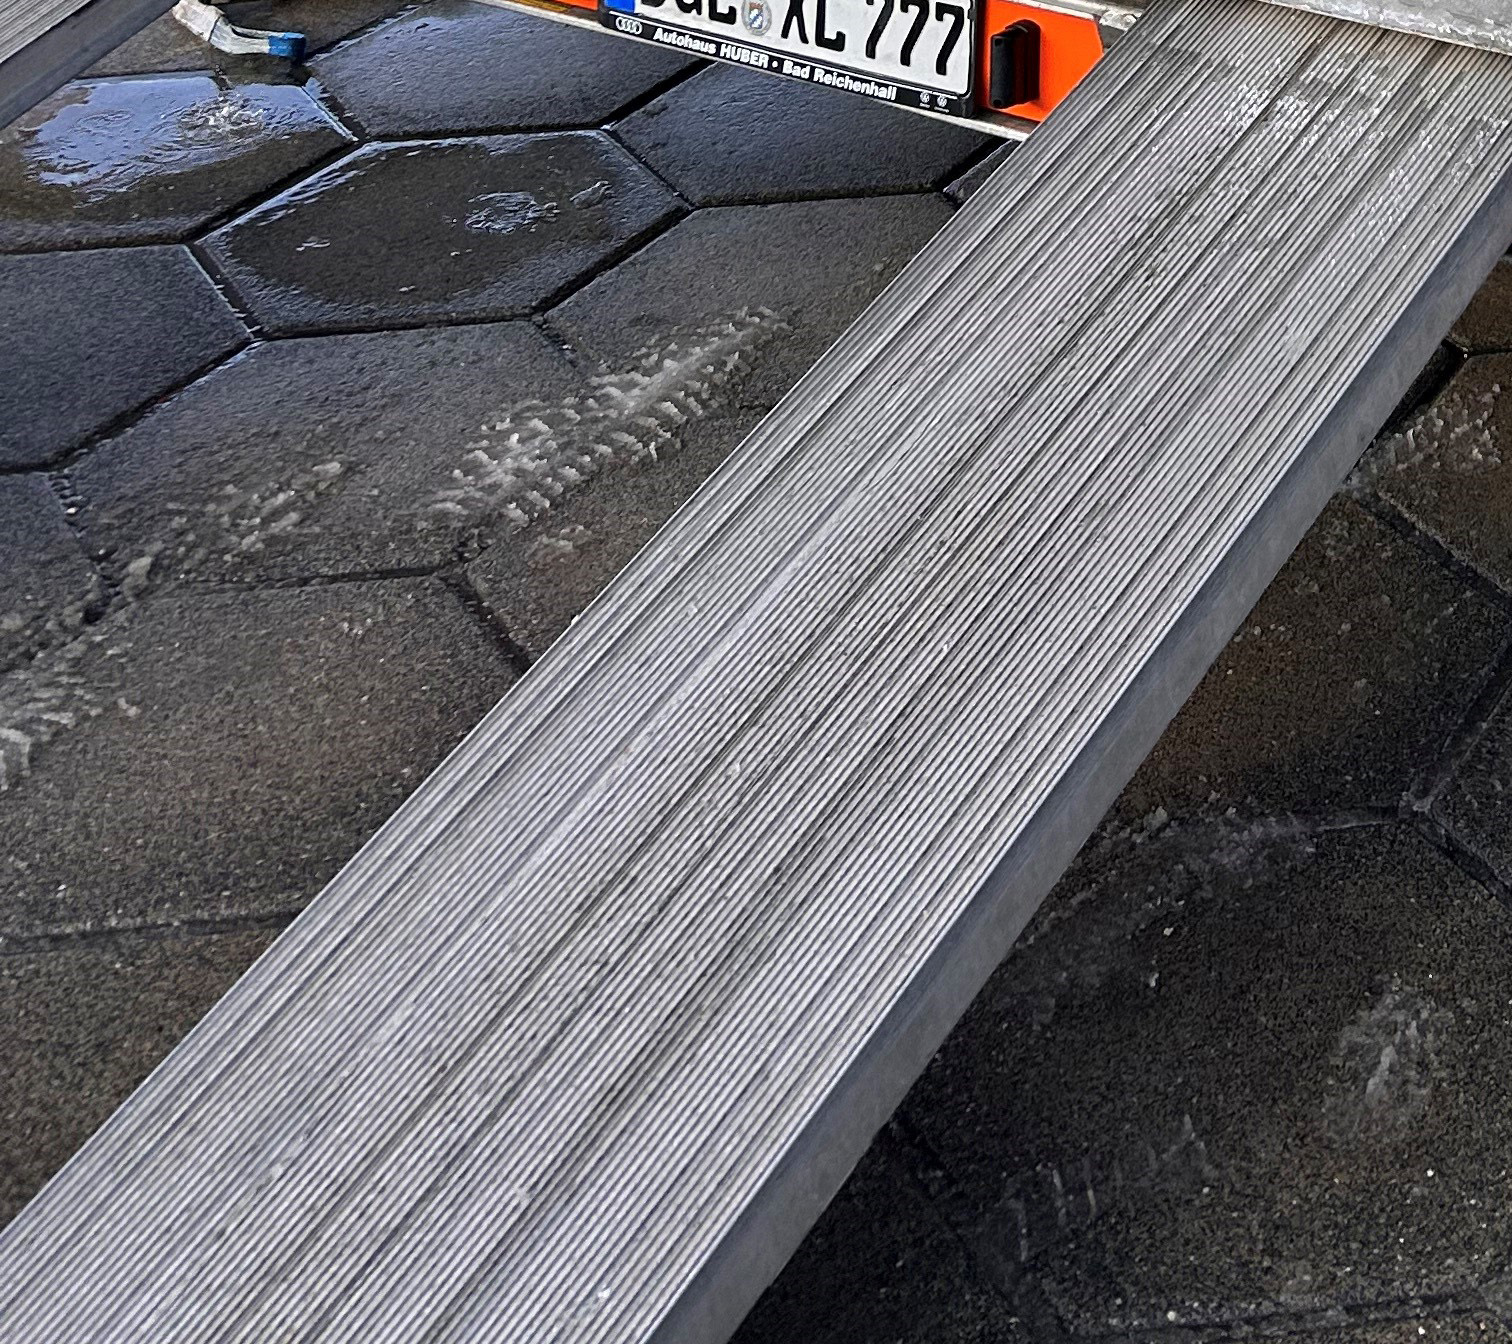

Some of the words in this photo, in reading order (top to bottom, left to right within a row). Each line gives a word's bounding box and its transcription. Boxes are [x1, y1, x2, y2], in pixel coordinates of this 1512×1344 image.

[653, 27, 717, 55] Autohaus
[719, 43, 770, 69] HUBER
[782, 59, 810, 80] Bad
[813, 68, 897, 100] Reichenhall
